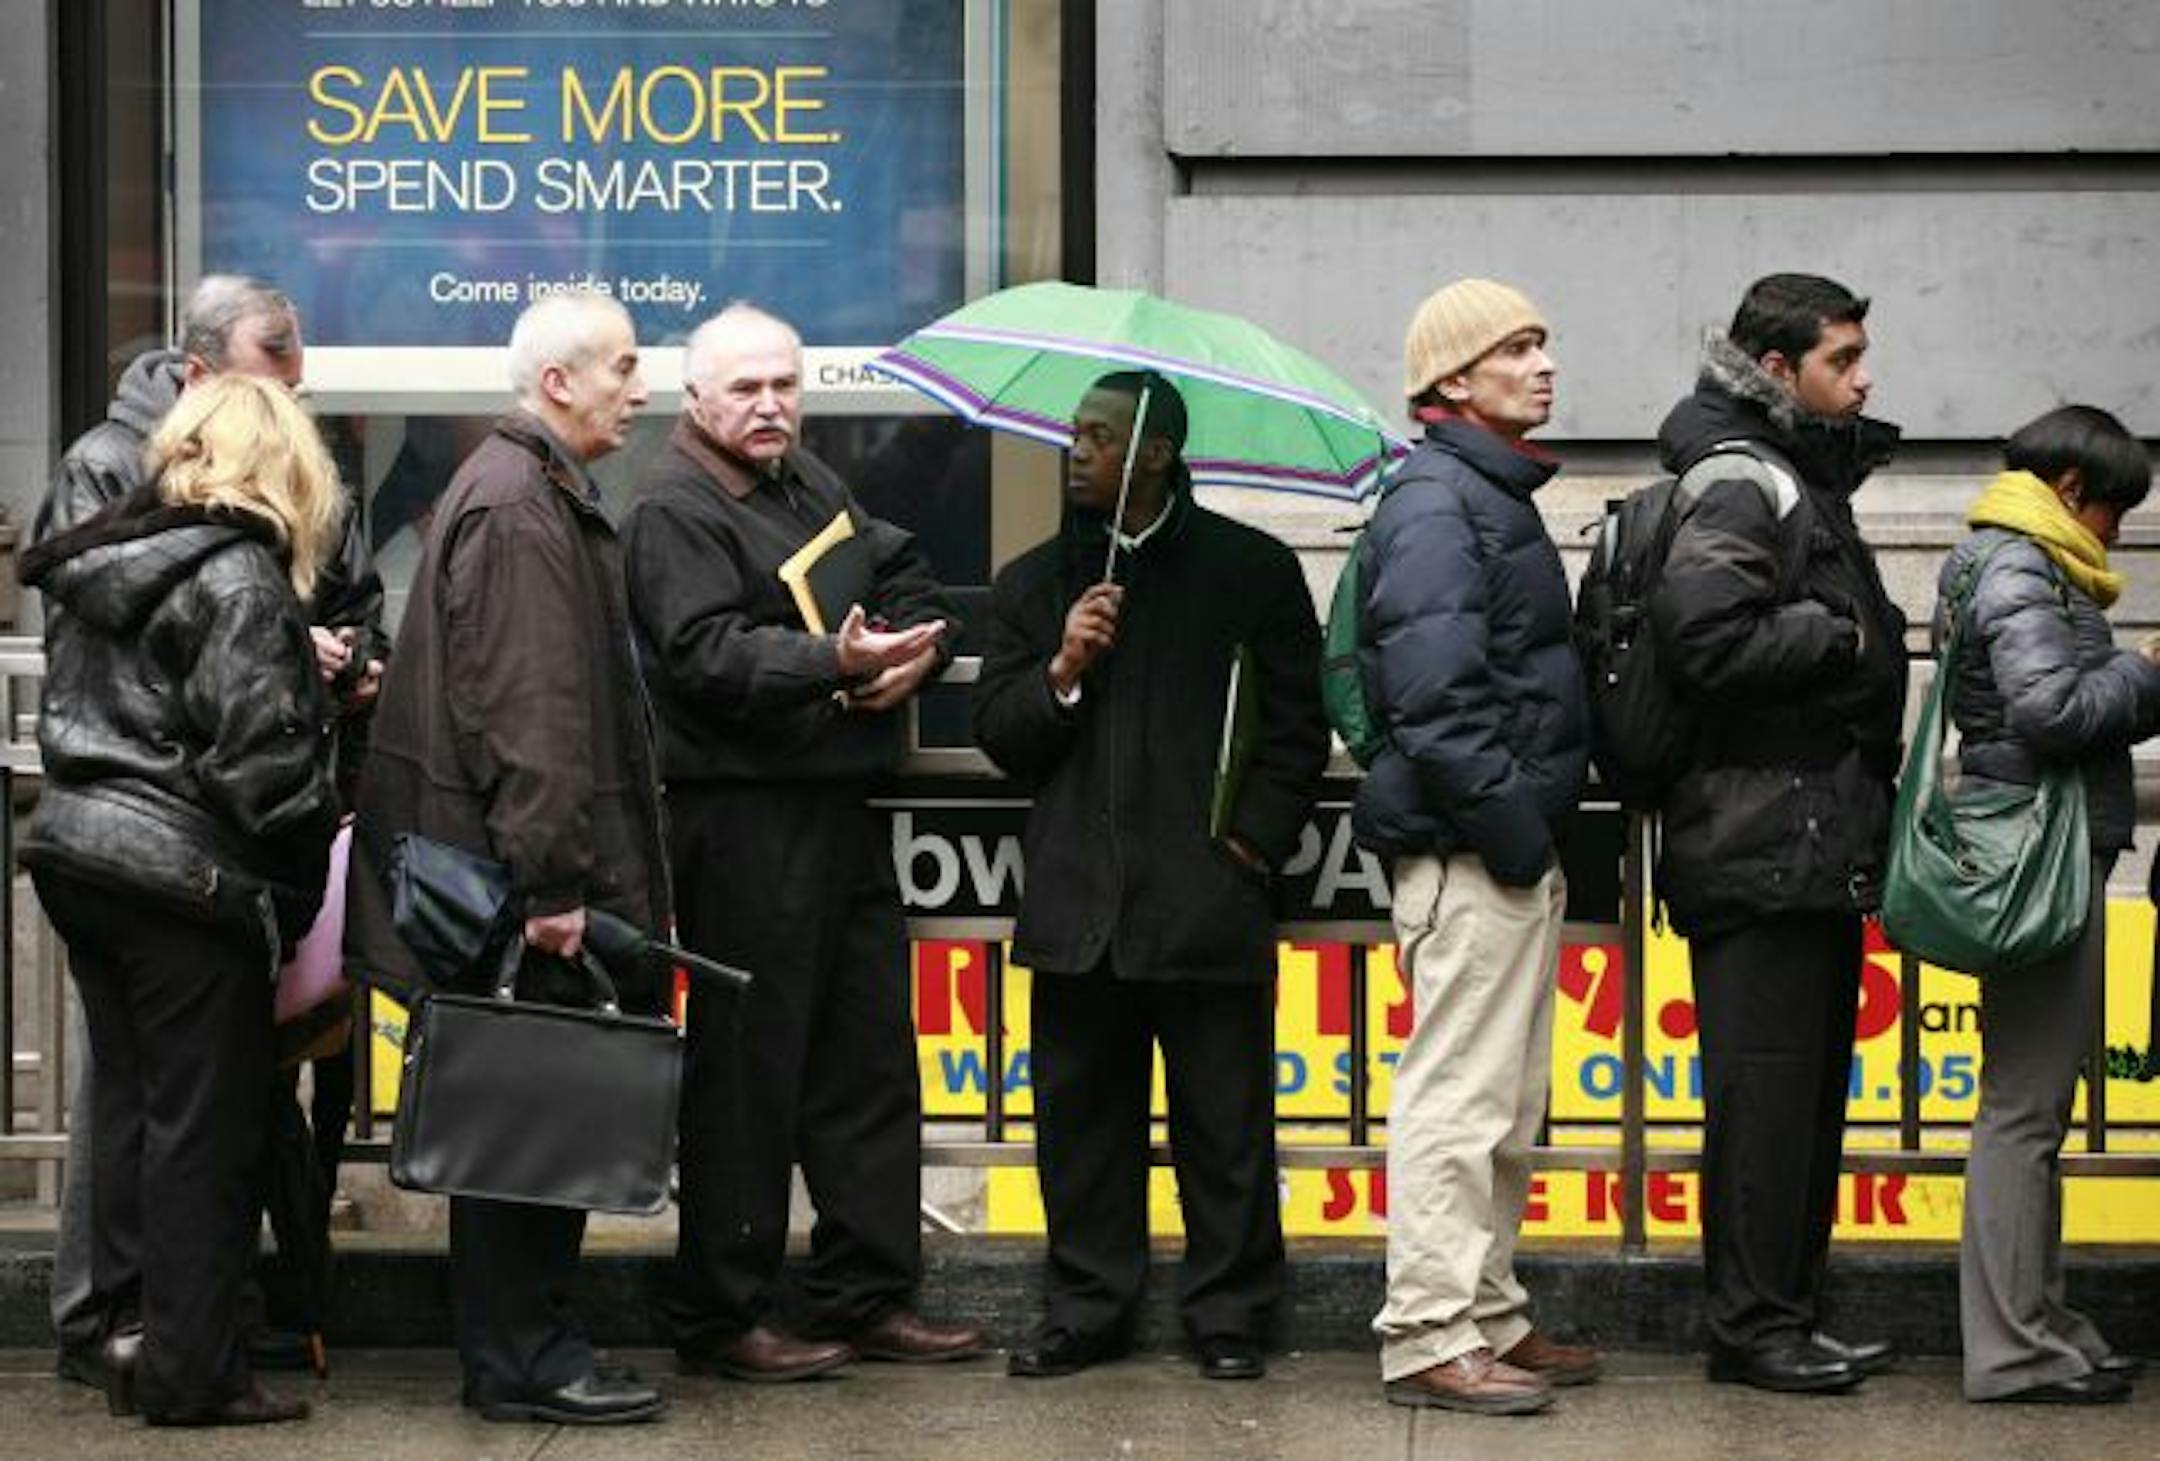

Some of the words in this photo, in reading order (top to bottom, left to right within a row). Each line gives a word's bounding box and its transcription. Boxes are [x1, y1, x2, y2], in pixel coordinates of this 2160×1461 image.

[304, 65, 532, 146] SAVE
[561, 65, 844, 146] MORE.
[304, 158, 517, 213] SPEND
[534, 158, 844, 213] SMARTER.
[430, 271, 519, 302] Come
[619, 272, 707, 312] today.
